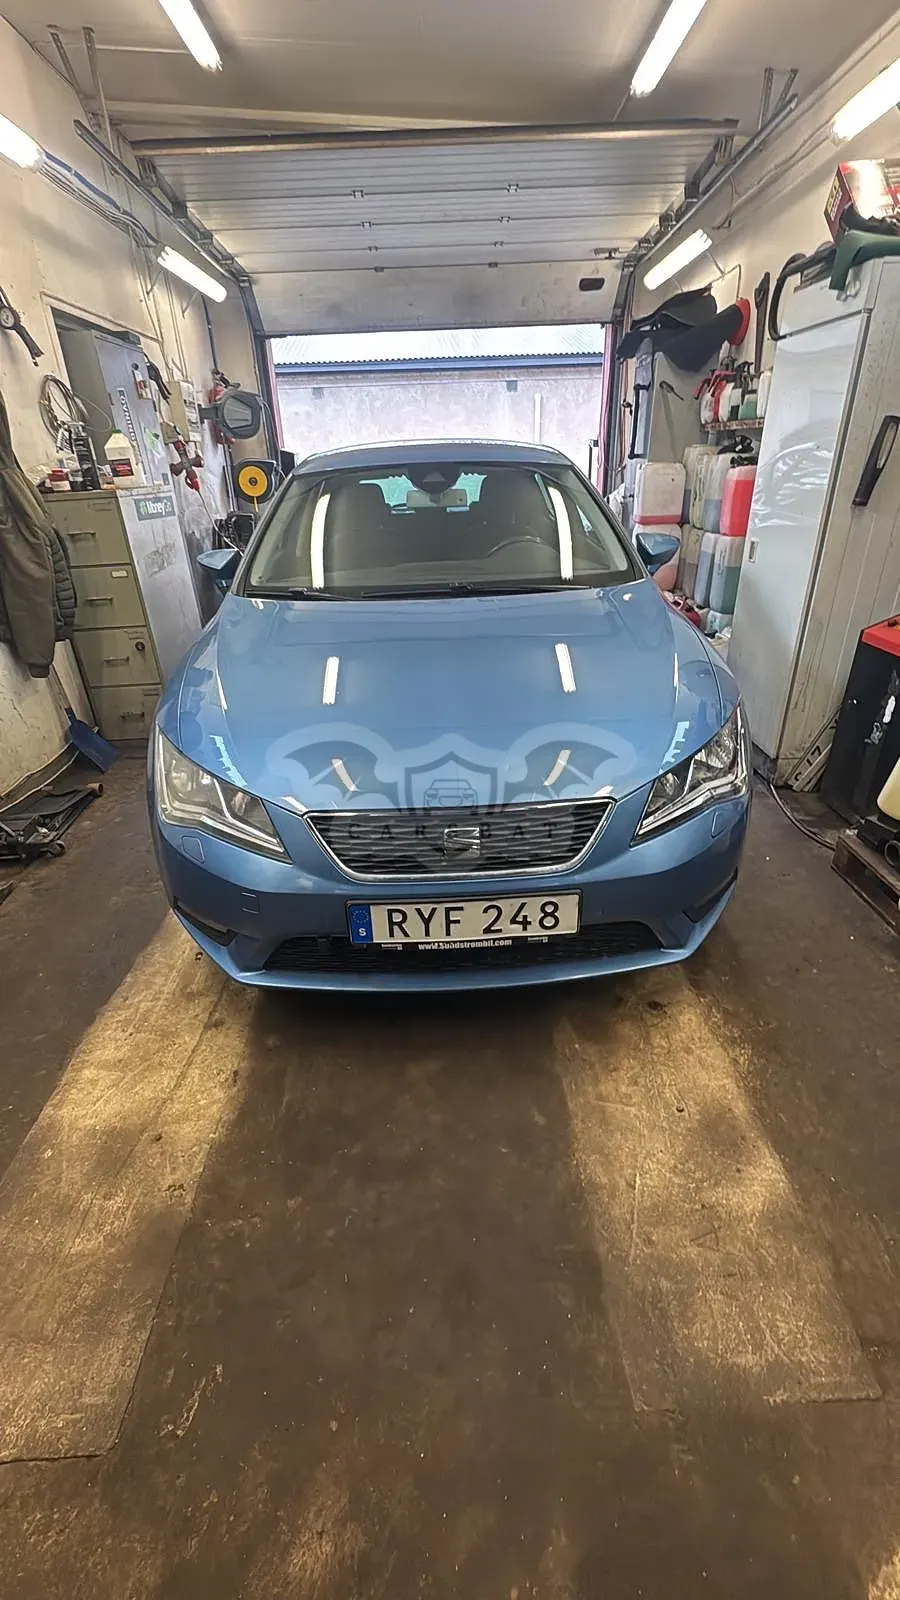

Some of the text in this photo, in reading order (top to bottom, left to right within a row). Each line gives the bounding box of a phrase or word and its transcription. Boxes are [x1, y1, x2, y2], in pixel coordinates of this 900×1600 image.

[358, 927, 367, 937] S
[386, 901, 560, 939] RYF 248
